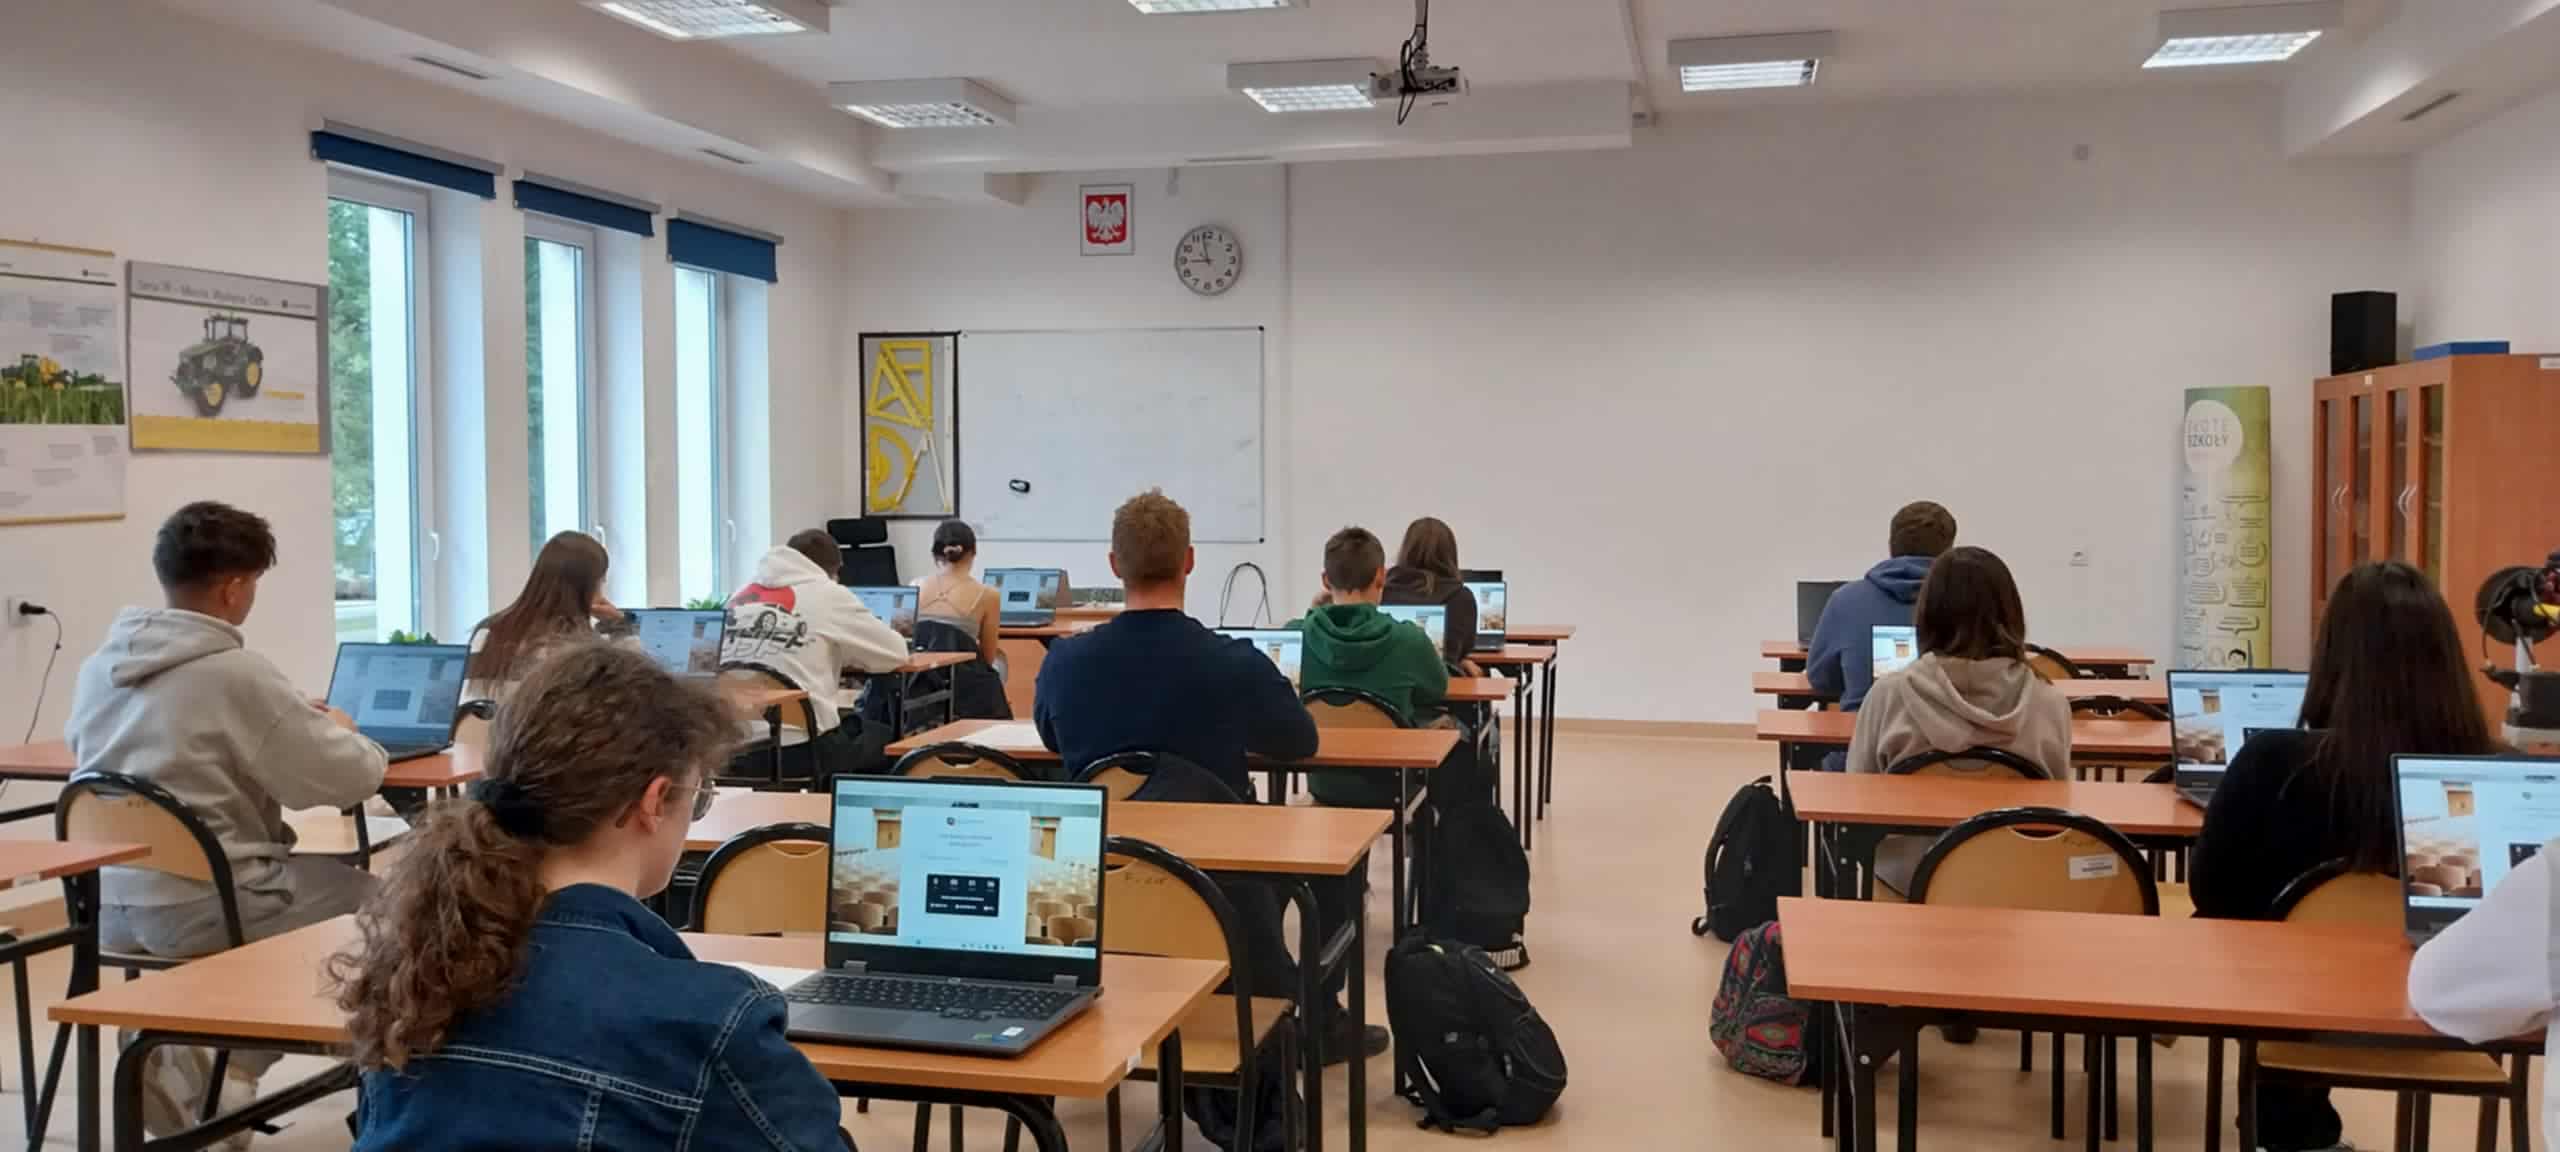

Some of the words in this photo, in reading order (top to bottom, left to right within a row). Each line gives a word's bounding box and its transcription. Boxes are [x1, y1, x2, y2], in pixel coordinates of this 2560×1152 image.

[1192, 233, 1200, 243] 11
[1224, 243, 1232, 252] 2
[1224, 268, 1232, 277] 4
